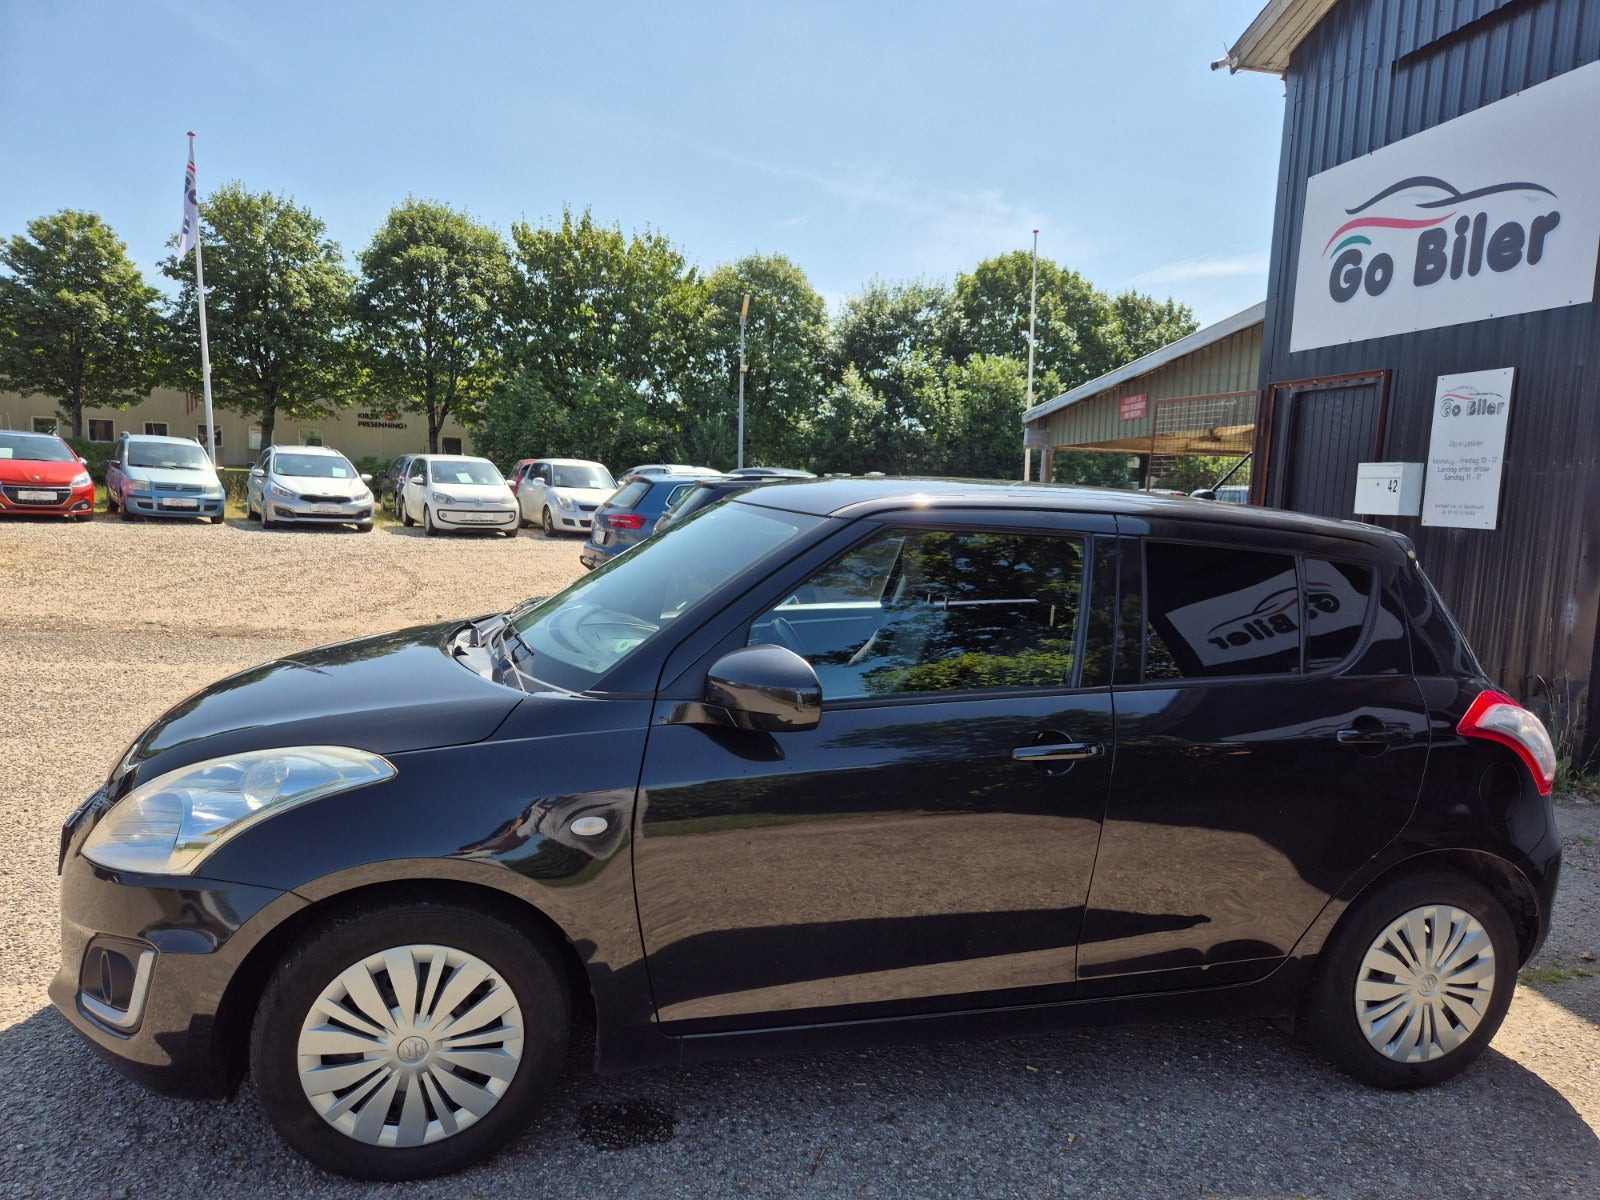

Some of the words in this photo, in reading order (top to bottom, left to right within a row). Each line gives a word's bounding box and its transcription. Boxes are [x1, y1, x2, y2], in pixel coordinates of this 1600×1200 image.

[1328, 248, 1394, 303] Go
[1412, 210, 1561, 287] Biler
[1440, 401, 1462, 417] Go
[1466, 398, 1505, 416] Biler
[1387, 479, 1398, 493] 42
